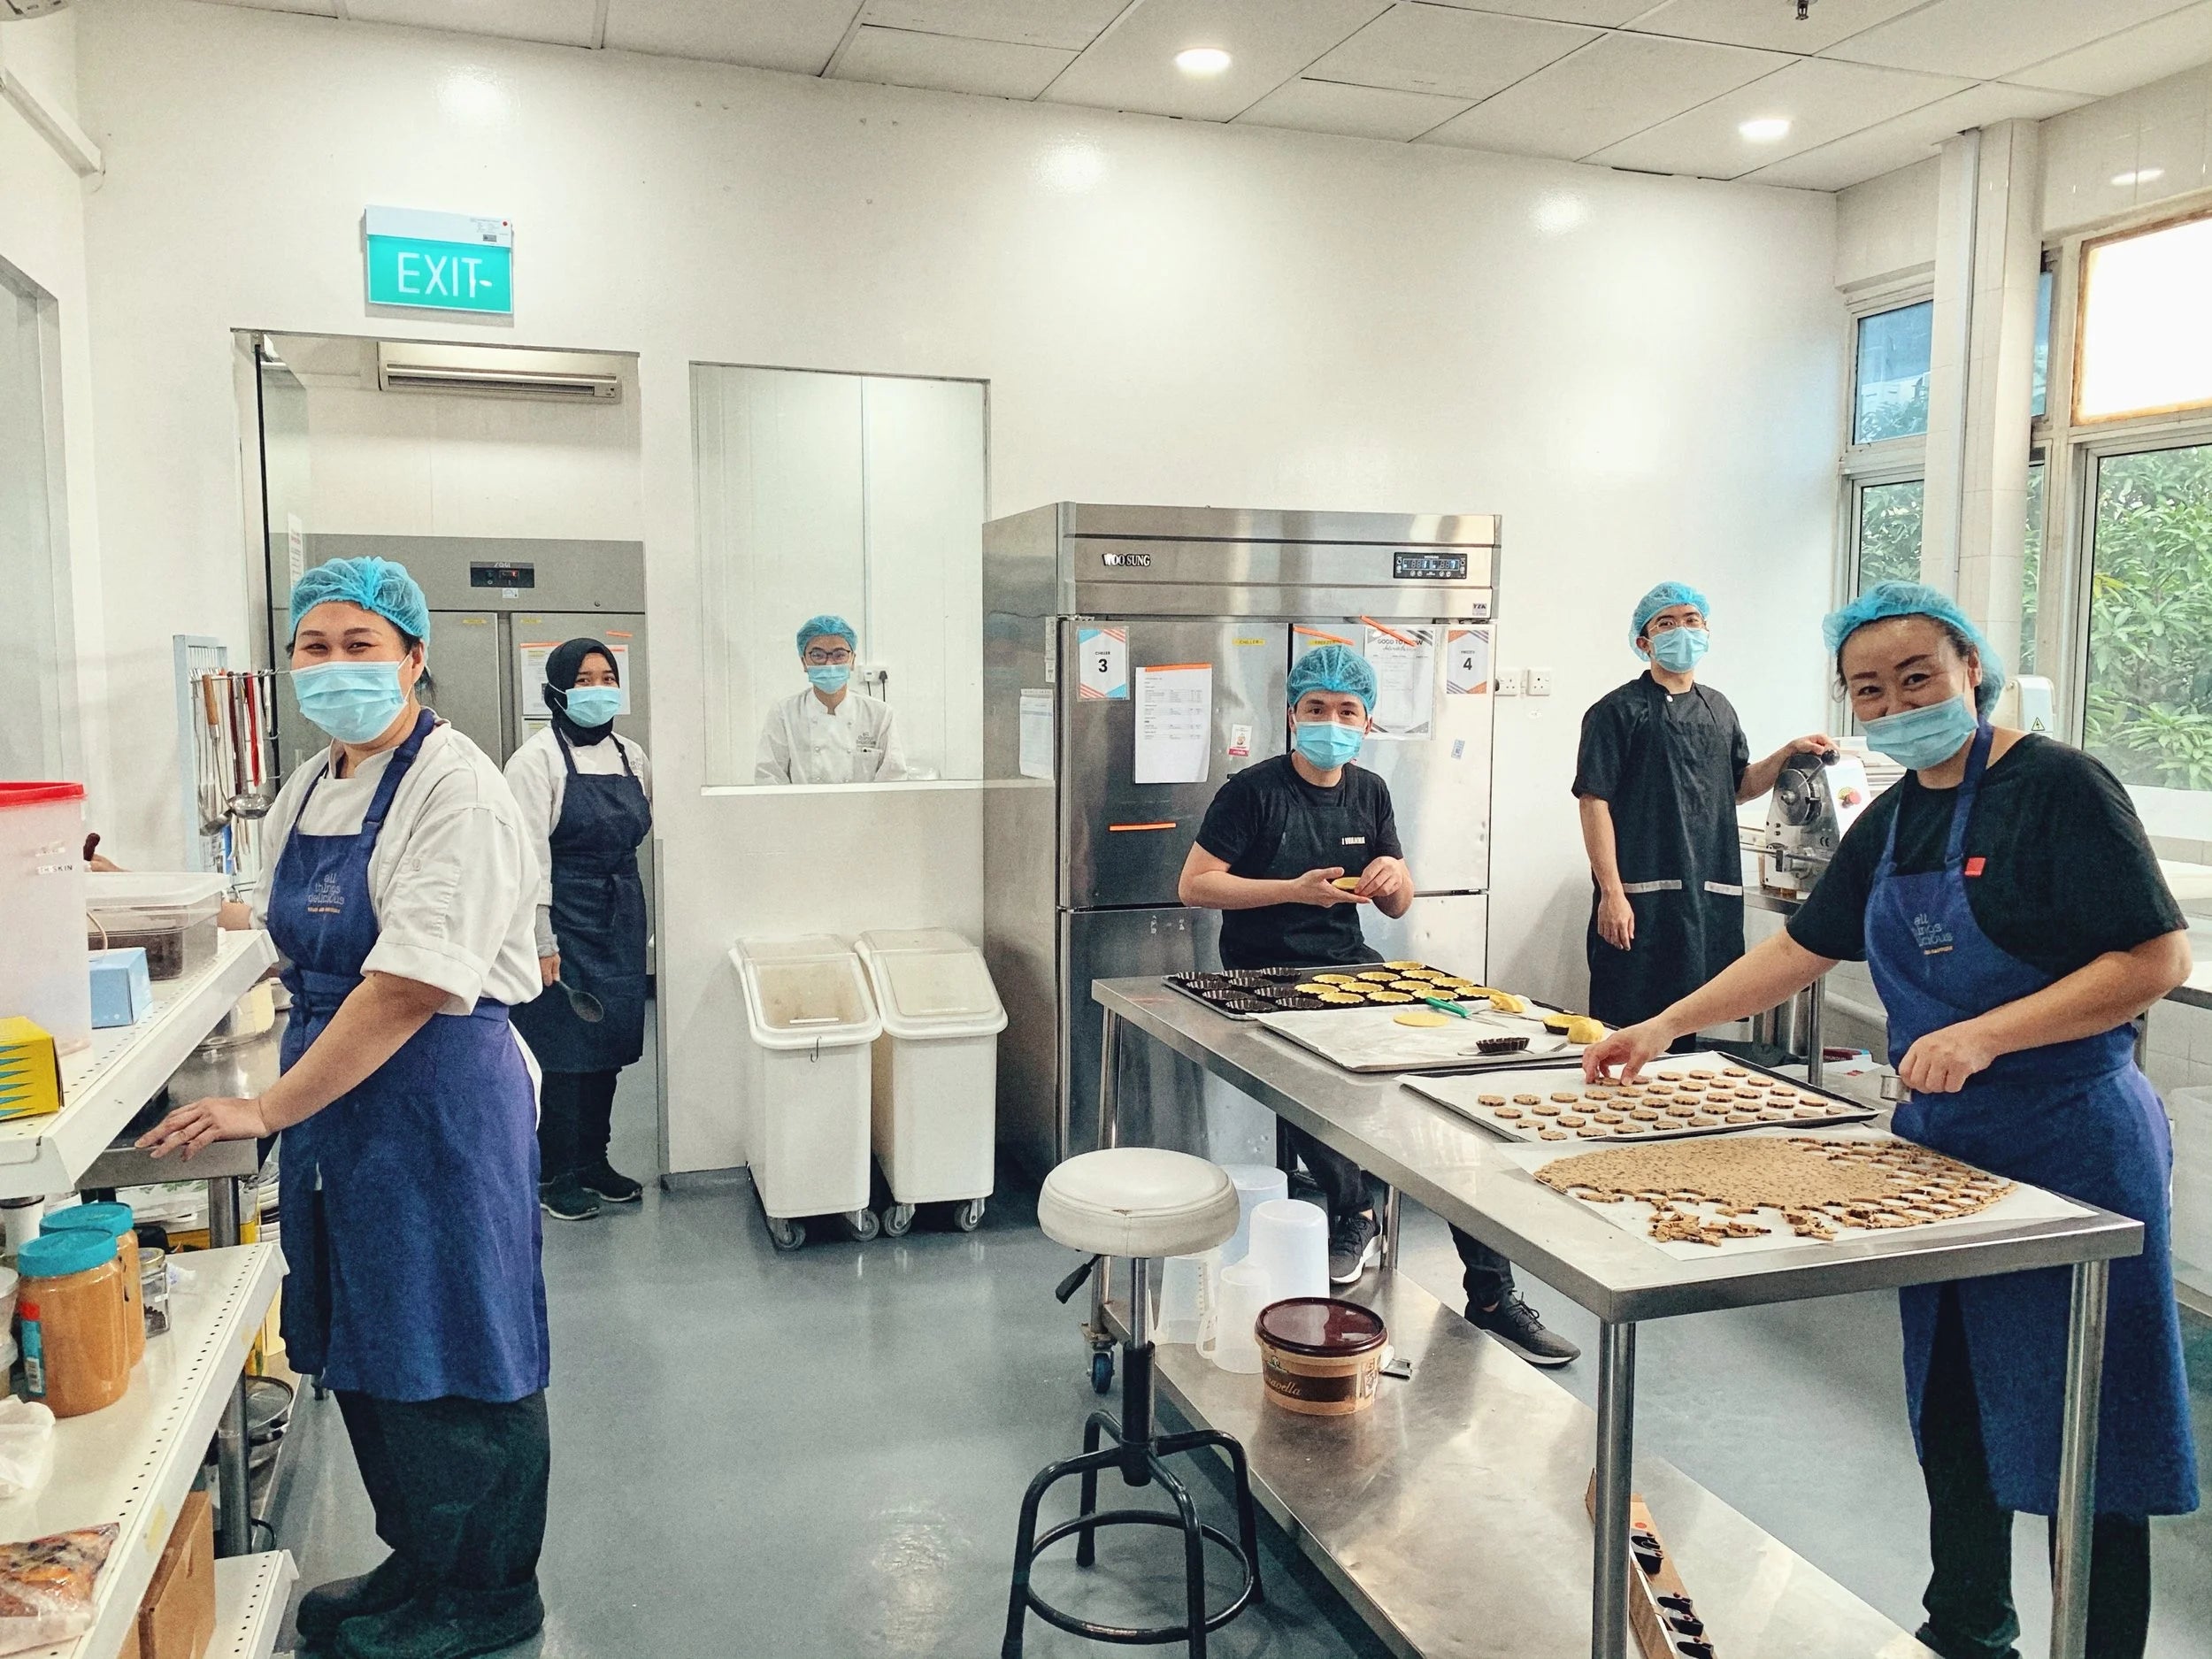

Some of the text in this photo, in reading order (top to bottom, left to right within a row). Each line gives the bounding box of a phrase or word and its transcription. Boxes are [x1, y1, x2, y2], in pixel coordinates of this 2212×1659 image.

[398, 251, 483, 298] EXIT
[1125, 554, 1151, 566] SUNG
[1098, 658, 1108, 673] 3
[1463, 657, 1472, 671] 4
[324, 872, 336, 884] all
